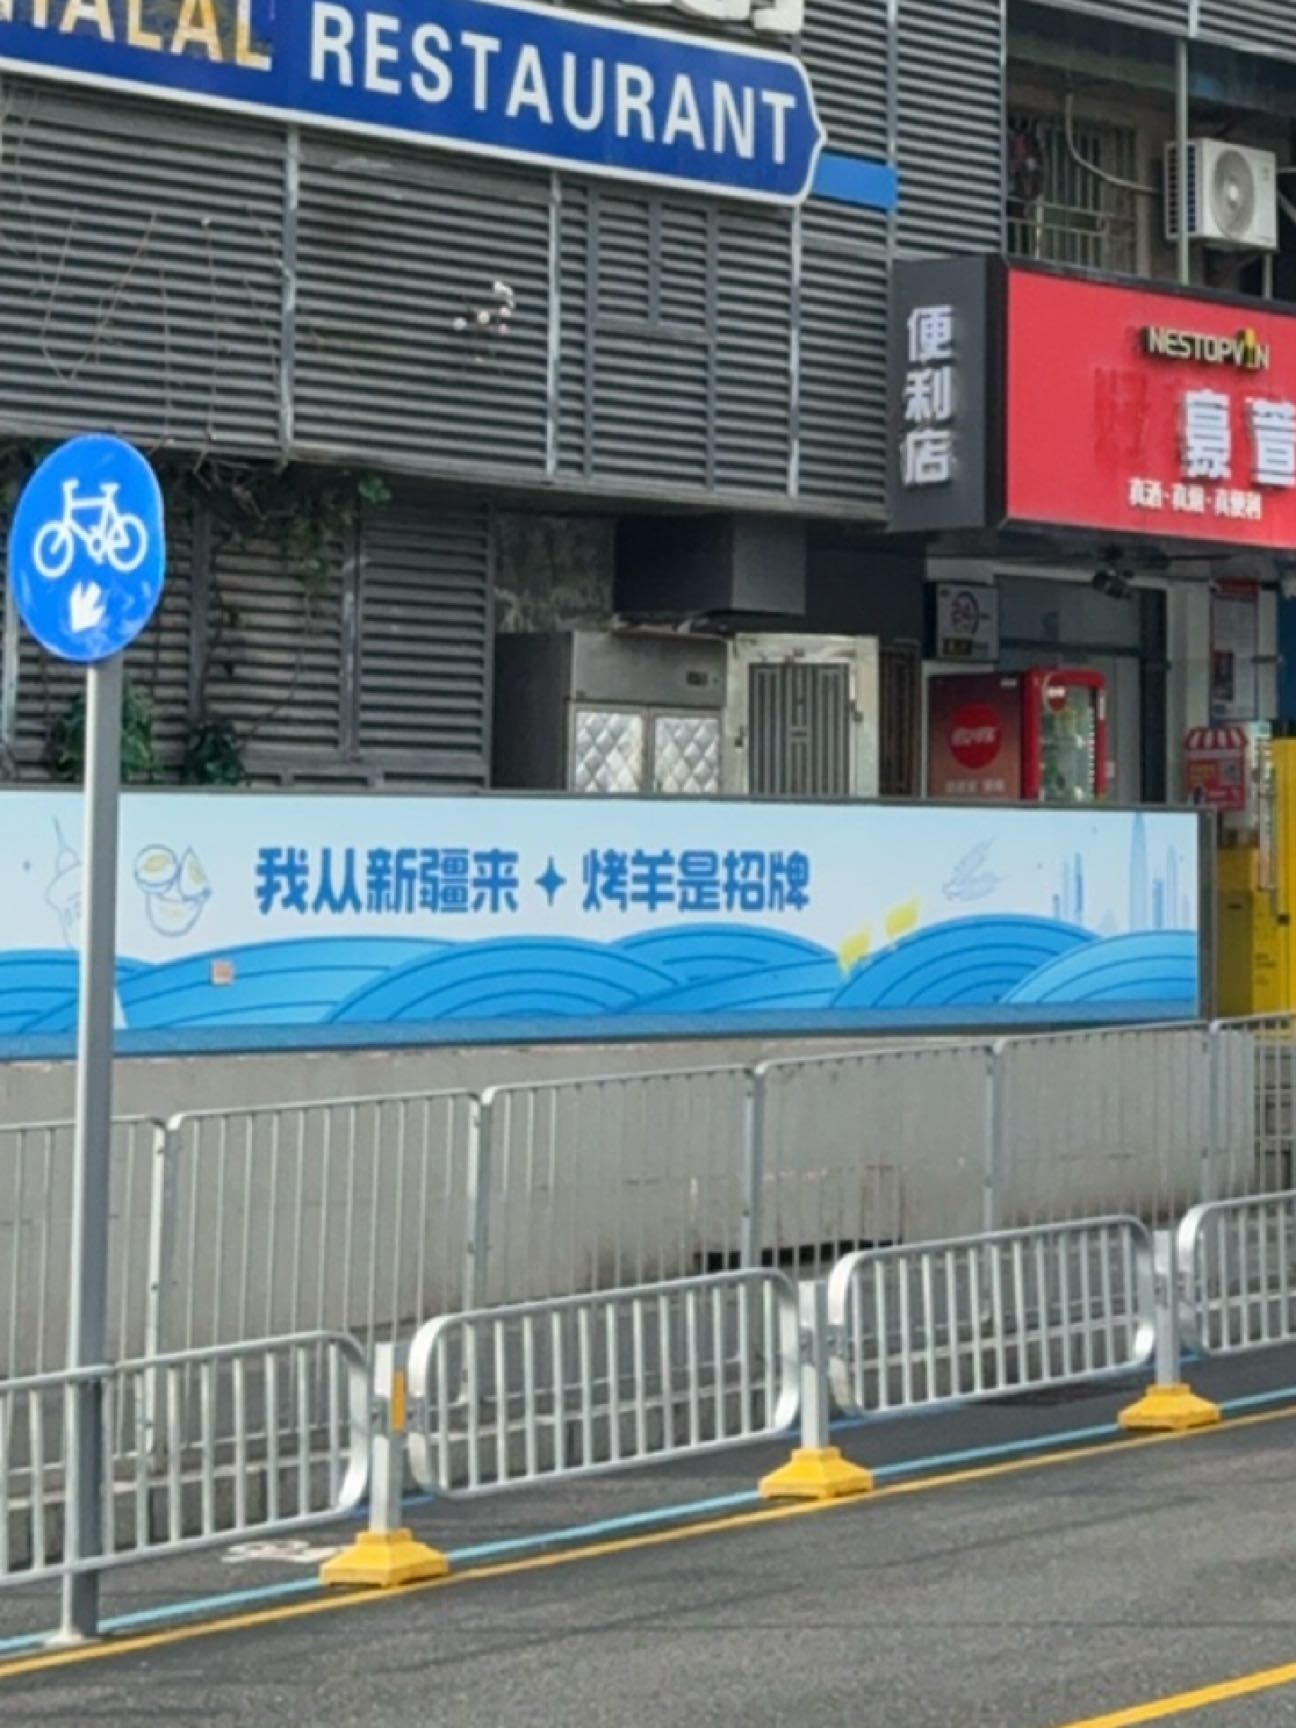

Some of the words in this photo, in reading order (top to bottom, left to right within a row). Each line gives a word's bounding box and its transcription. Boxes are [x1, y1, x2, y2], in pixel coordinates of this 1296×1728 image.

[310, 1, 796, 165] RESTAURANT
[903, 305, 953, 487] 便利店
[255, 846, 520, 915] 我从新疆来
[581, 847, 812, 912] 烤羊是招牌
